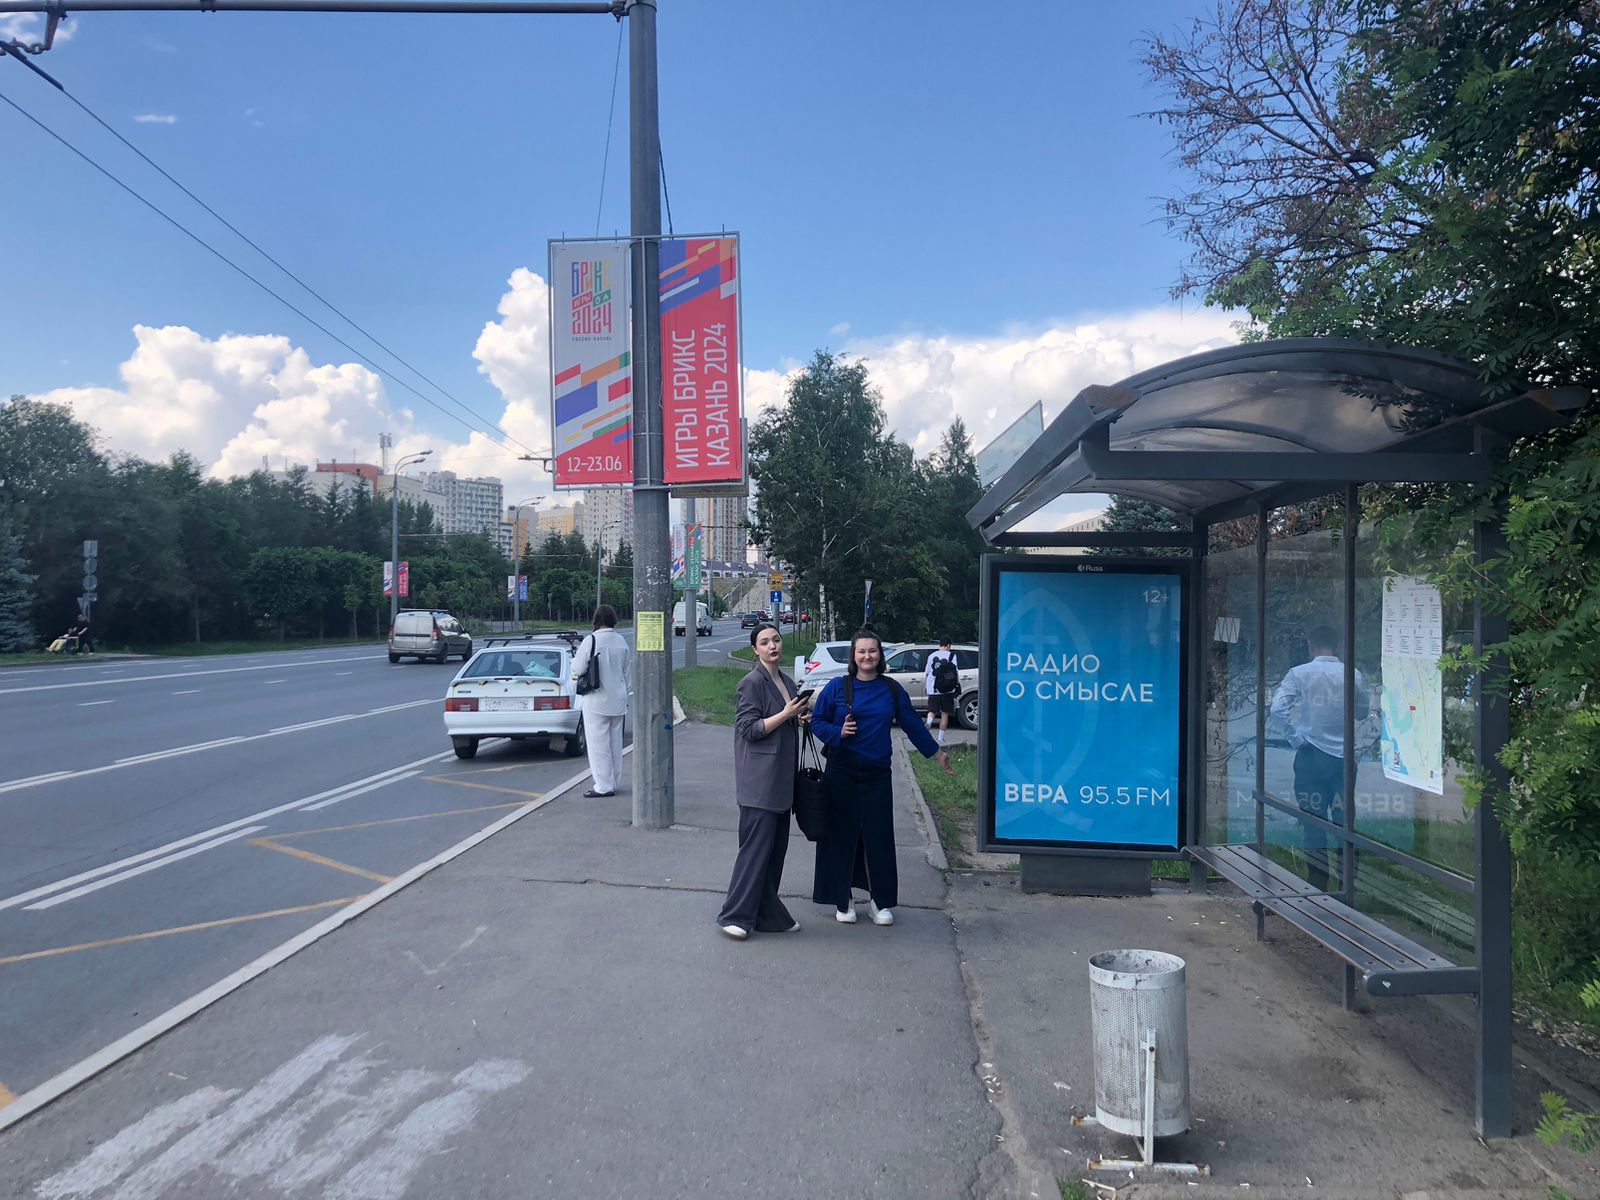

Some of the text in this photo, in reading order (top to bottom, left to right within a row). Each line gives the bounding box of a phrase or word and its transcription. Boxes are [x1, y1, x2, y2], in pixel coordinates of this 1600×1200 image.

[571, 302, 612, 334] 2024
[672, 329, 699, 468] ИГРЫ БРИКС
[703, 322, 730, 466] КАЗАНЬ 2024
[1142, 589, 1170, 603] 12+
[1006, 652, 1100, 675] РАДИО
[1006, 680, 1154, 702] О СМЫСЛЕ
[1004, 783, 1170, 806] ВЕРА 95.5 FM
